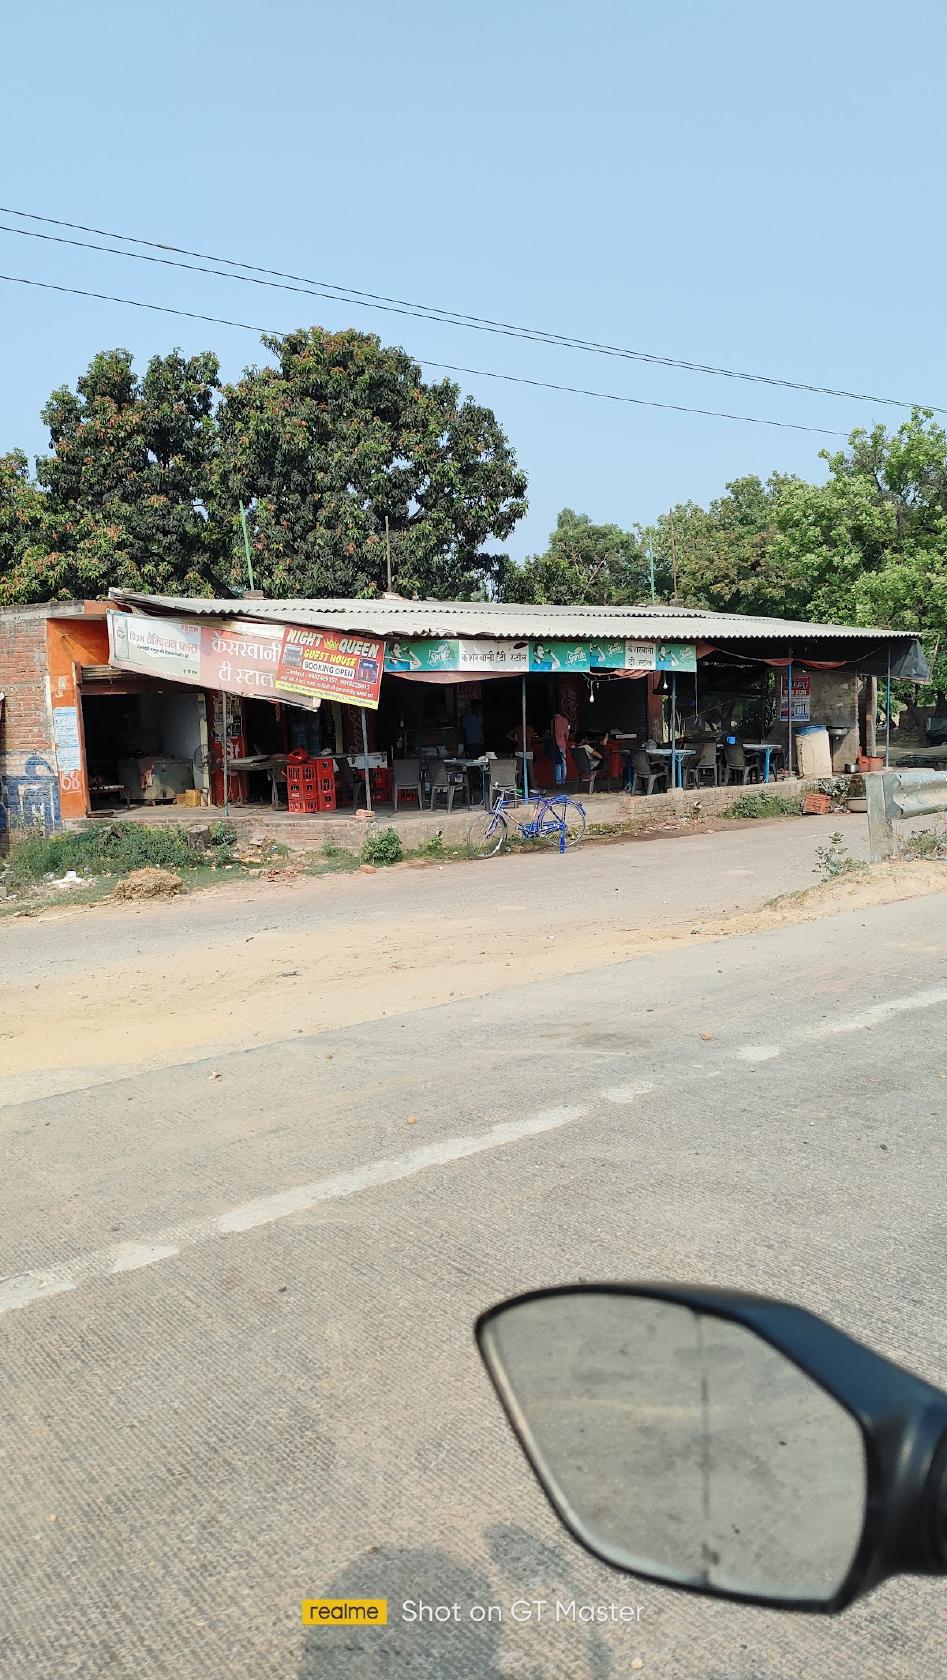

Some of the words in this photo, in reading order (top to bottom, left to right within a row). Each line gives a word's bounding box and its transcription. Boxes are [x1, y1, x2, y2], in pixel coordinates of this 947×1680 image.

[286, 629, 324, 648] NIGHT
[339, 639, 379, 658] QUEEN
[303, 649, 329, 662] GUEST
[330, 653, 357, 667] HOUSE
[430, 647, 452, 663] Sprite
[567, 651, 586, 665] Sprite
[218, 661, 232, 682] टी
[304, 662, 334, 674] BOOKING
[335, 667, 354, 678] OPEN
